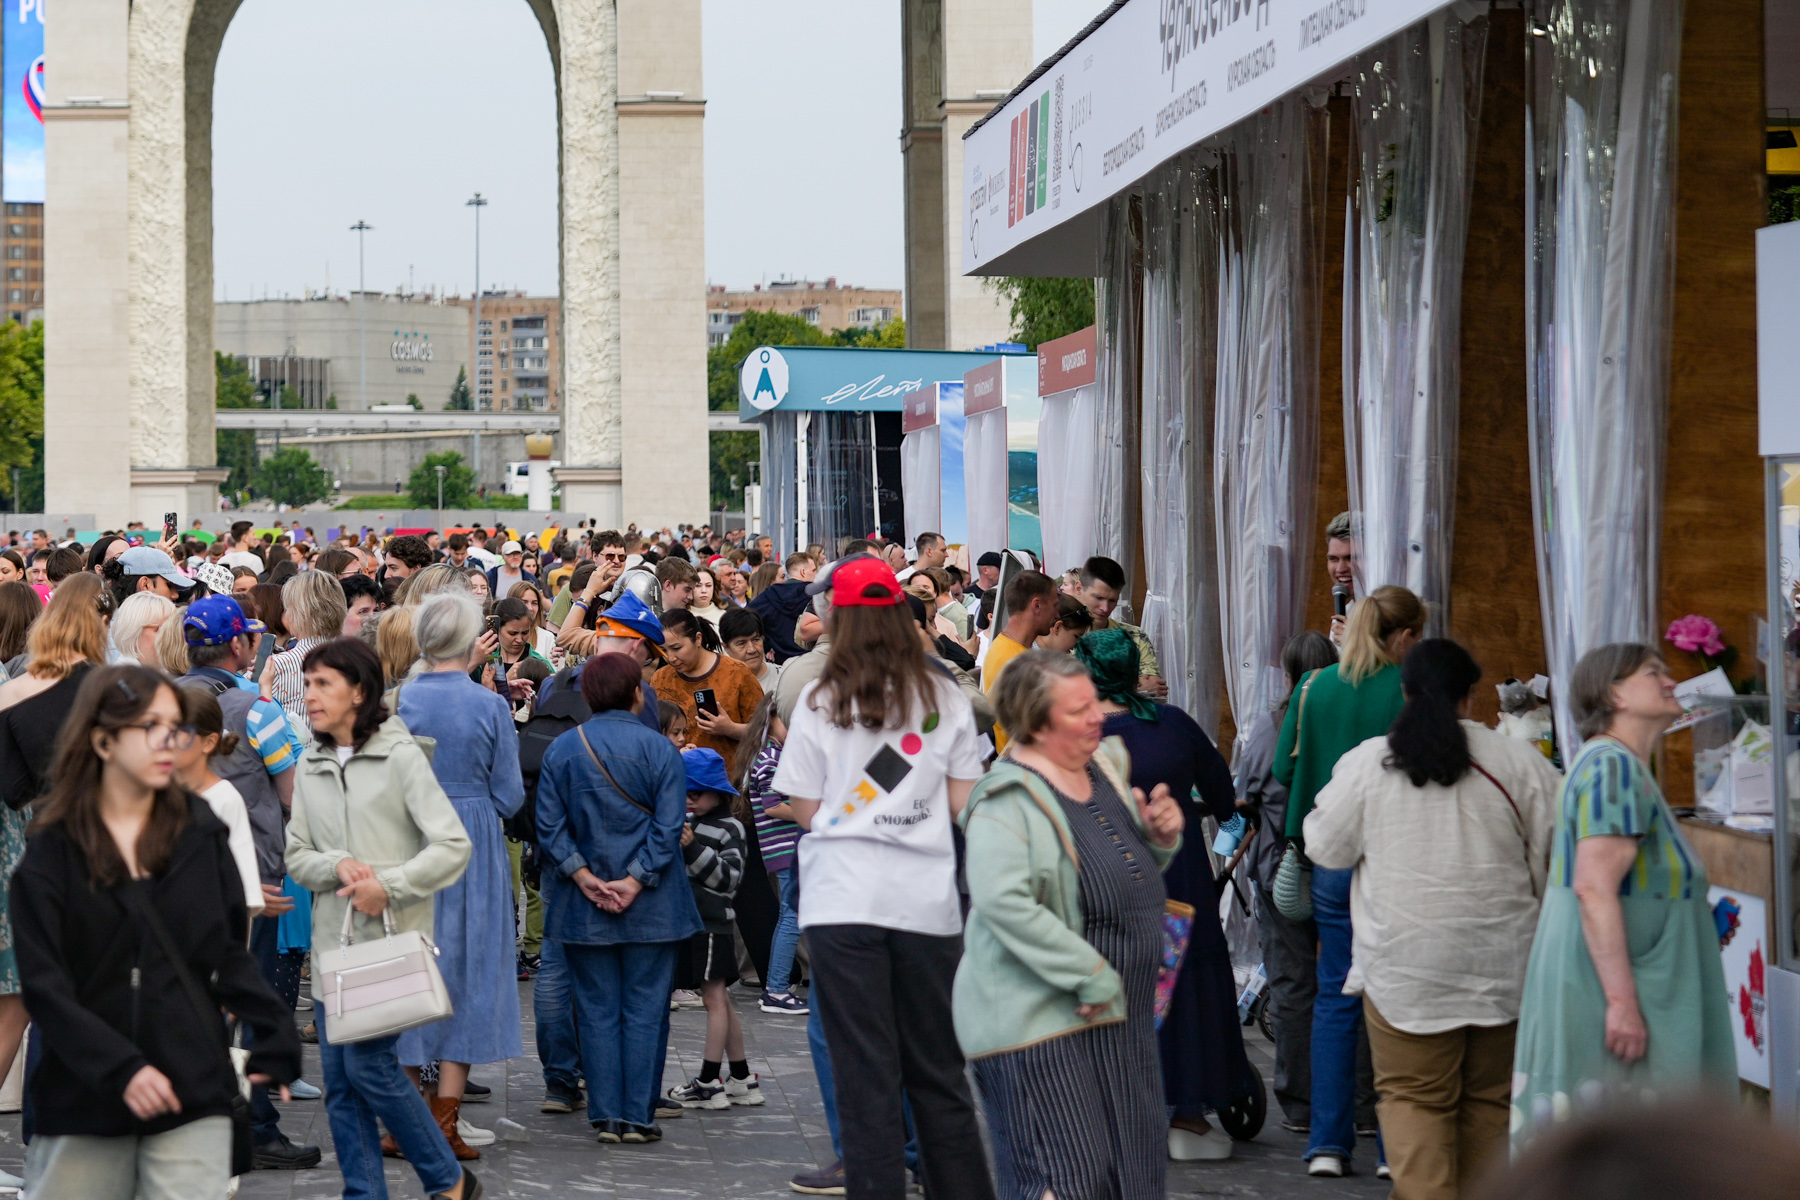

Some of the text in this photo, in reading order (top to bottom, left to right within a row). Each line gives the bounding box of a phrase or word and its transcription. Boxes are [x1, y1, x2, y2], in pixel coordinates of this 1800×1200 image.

[1299, 1, 1333, 53] ЛИПЕЦКАЯ
[390, 341, 433, 362] COSMOS
[913, 799, 926, 810] ЕС
